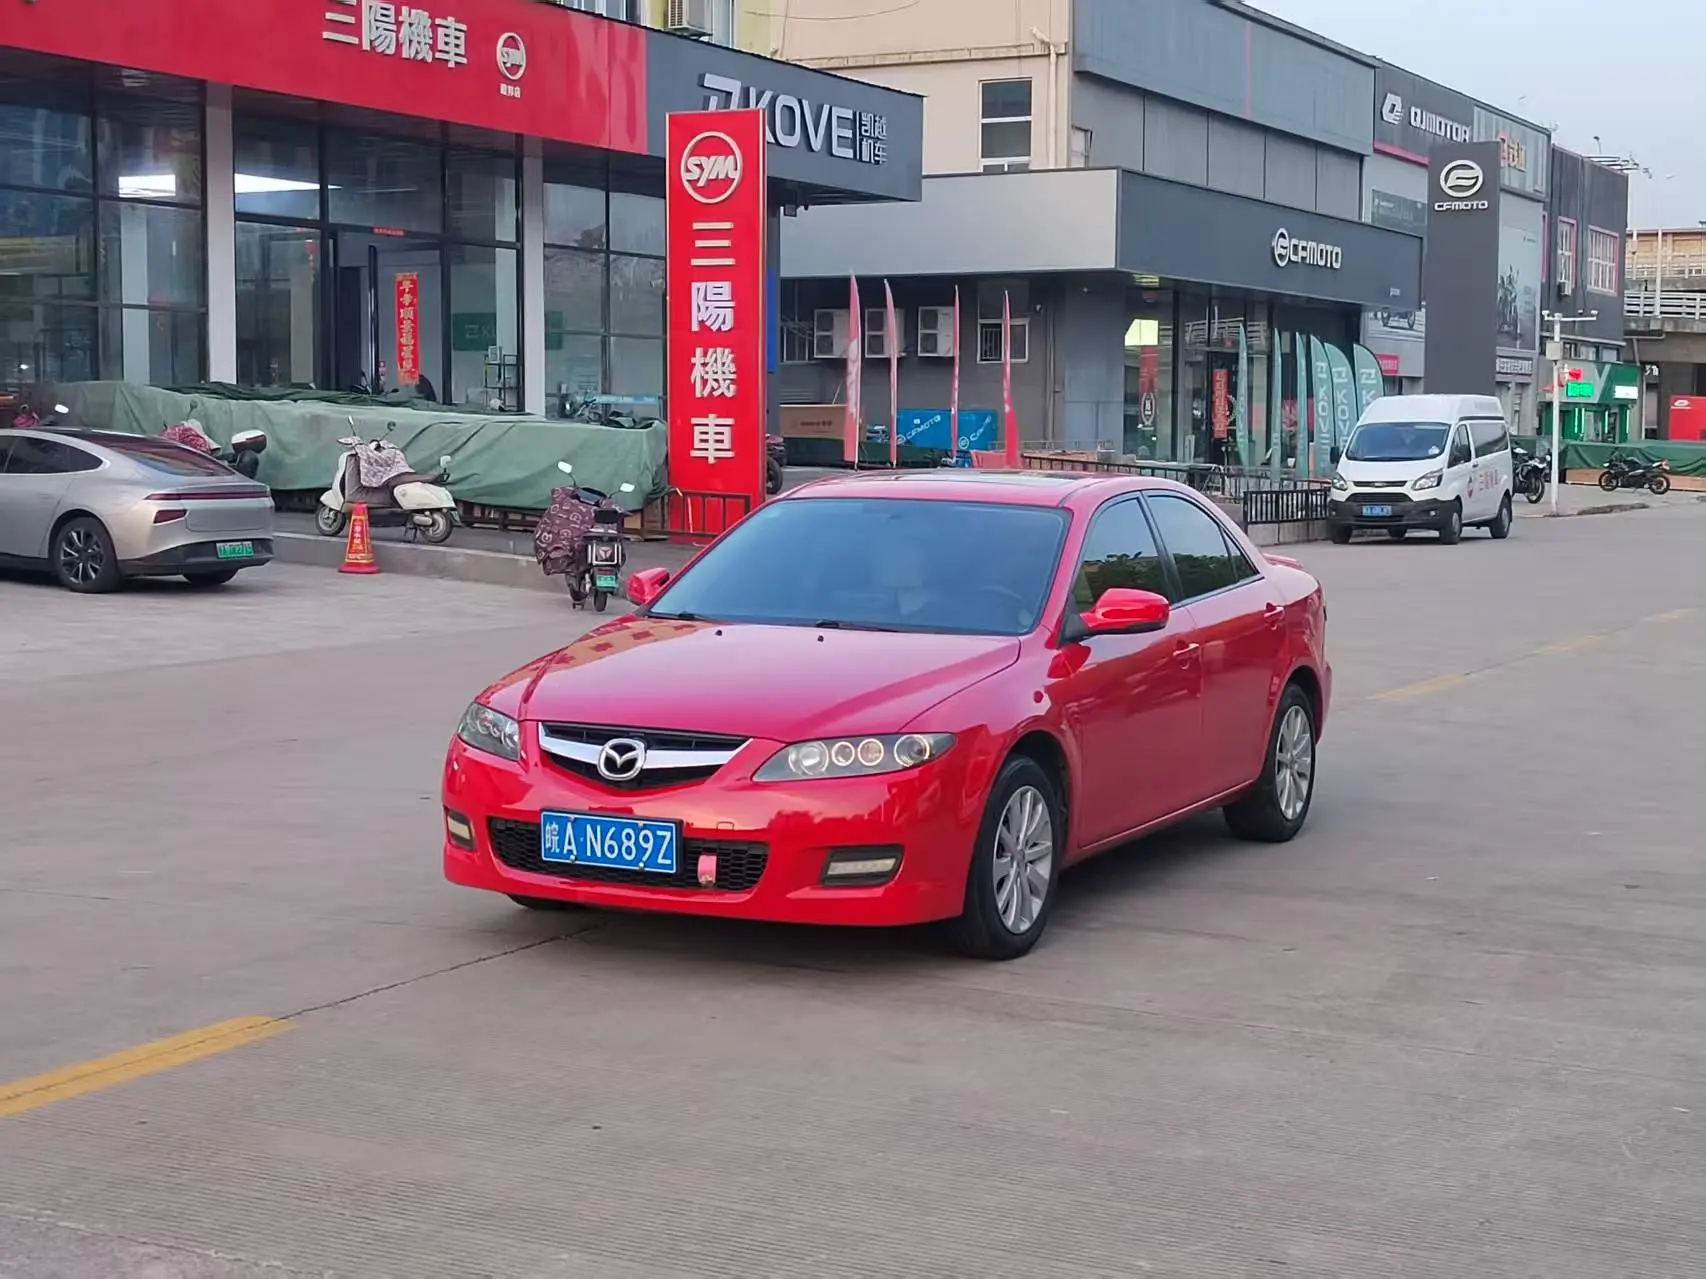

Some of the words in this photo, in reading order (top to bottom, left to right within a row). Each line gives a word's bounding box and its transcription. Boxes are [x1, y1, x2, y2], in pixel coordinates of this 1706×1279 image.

[322, 0, 467, 68] 三陽機車
[749, 86, 854, 160] KOVE
[861, 111, 887, 140] 凯越
[861, 138, 887, 165] 机车
[684, 155, 738, 187] SYM
[1434, 200, 1488, 211] CFMOTO
[1290, 238, 1342, 269] CFMOTO
[690, 221, 737, 464] 三陽機車
